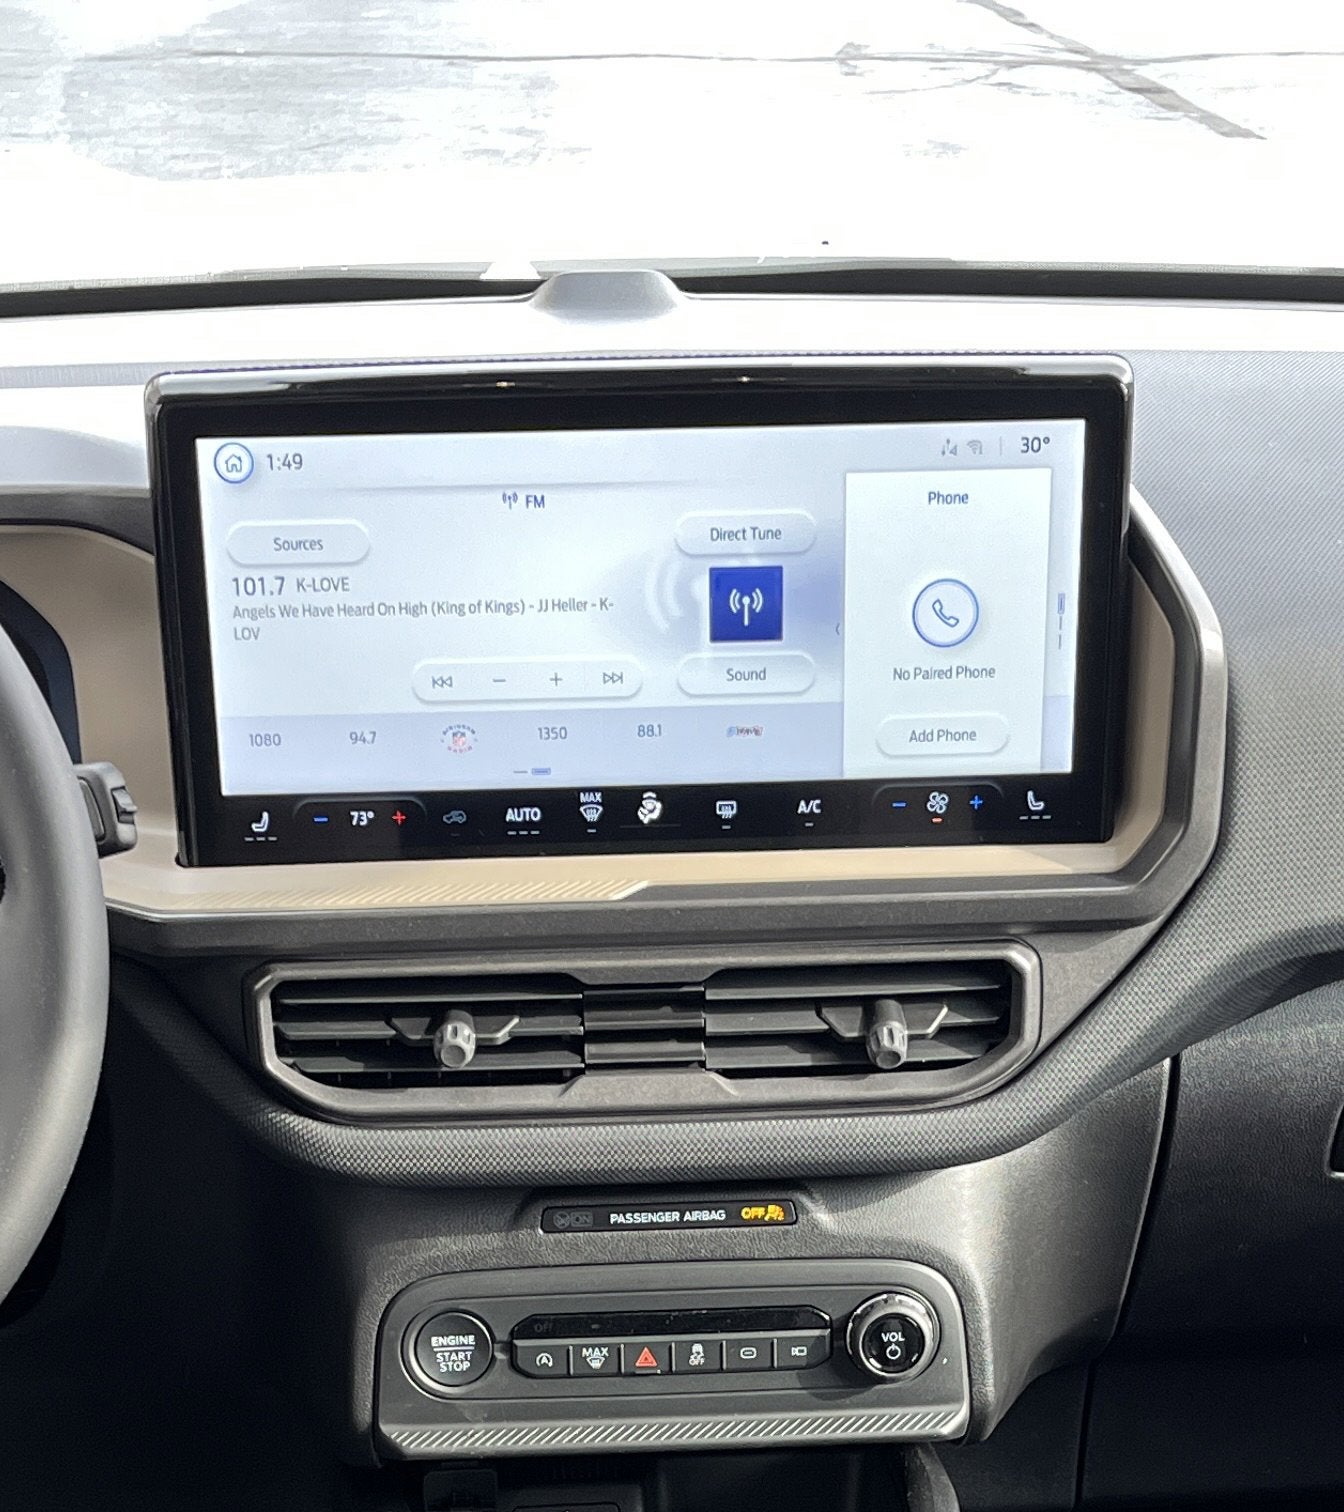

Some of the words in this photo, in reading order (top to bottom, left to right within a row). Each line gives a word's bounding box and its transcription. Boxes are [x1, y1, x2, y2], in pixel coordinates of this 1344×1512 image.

[1020, 435, 1051, 454] 30°
[266, 453, 304, 471] 1:49
[525, 494, 546, 510] FM
[927, 490, 969, 506] Phone
[709, 527, 747, 542] Direct
[750, 526, 782, 541] Tune
[273, 537, 324, 552] Sources
[232, 576, 286, 597] 101.7
[296, 576, 351, 594] K-LOVE
[233, 603, 276, 621] Angels
[279, 604, 300, 618] We
[302, 603, 334, 618] Have
[337, 603, 375, 617] Heard
[377, 602, 396, 616] On
[399, 601, 428, 617] High
[431, 601, 466, 617] (King
[468, 600, 483, 614] of
[485, 599, 526, 617] Kings)
[537, 599, 549, 614] JJ
[551, 598, 588, 613] Heller
[599, 597, 615, 612] K-
[233, 627, 260, 642] LOV
[725, 667, 767, 683] Sound
[892, 667, 910, 681] No
[913, 666, 953, 681] Paired
[955, 665, 996, 680] Phone
[349, 731, 377, 746] 94.7
[537, 726, 568, 741] 1350
[637, 724, 663, 738] 88.1
[909, 729, 934, 743] Add
[936, 728, 977, 743] Phone
[249, 733, 282, 747] 1080
[579, 792, 602, 803] MAX
[797, 799, 821, 815] A/C
[350, 811, 375, 826] 73°
[505, 808, 541, 823] AUTO
[609, 1211, 680, 1225] PASSENGER
[683, 1209, 727, 1223] AIRBAG
[741, 1206, 766, 1220] OFF
[430, 1334, 476, 1347] ENGINE
[881, 1331, 906, 1343] VOL
[436, 1352, 473, 1363] START
[581, 1346, 609, 1358] MAX
[439, 1362, 471, 1373] STOP
[689, 1357, 705, 1367] OFF
